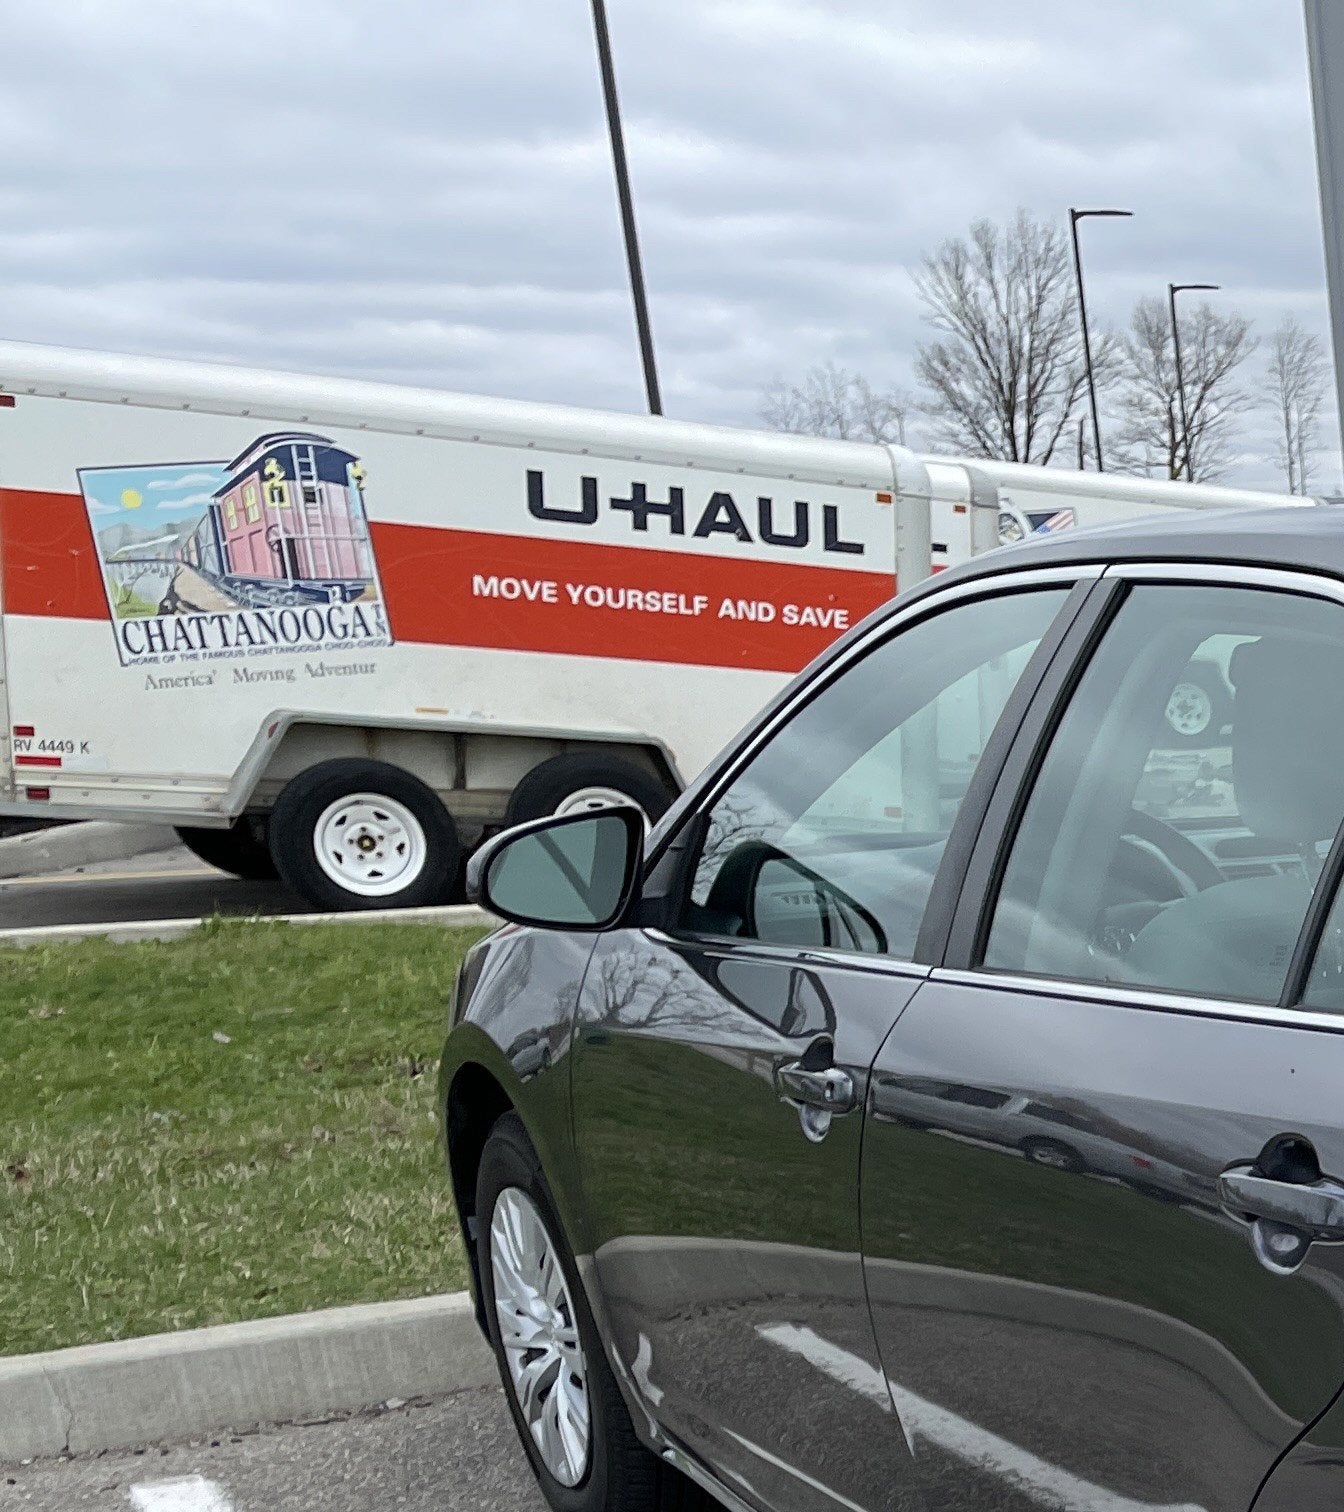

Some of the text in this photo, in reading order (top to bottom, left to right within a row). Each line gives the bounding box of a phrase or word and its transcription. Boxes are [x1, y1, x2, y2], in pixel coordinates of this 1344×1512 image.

[527, 469, 865, 554] U-HAUL
[472, 575, 849, 630] MOVE YOURSELF AND SAVE
[122, 604, 372, 655] CHATTANOOGA
[202, 647, 246, 660] FAMOUS
[247, 643, 322, 657] CHATTANOOGA
[232, 665, 297, 684] Moving
[13, 739, 90, 755] RV 4449 K
